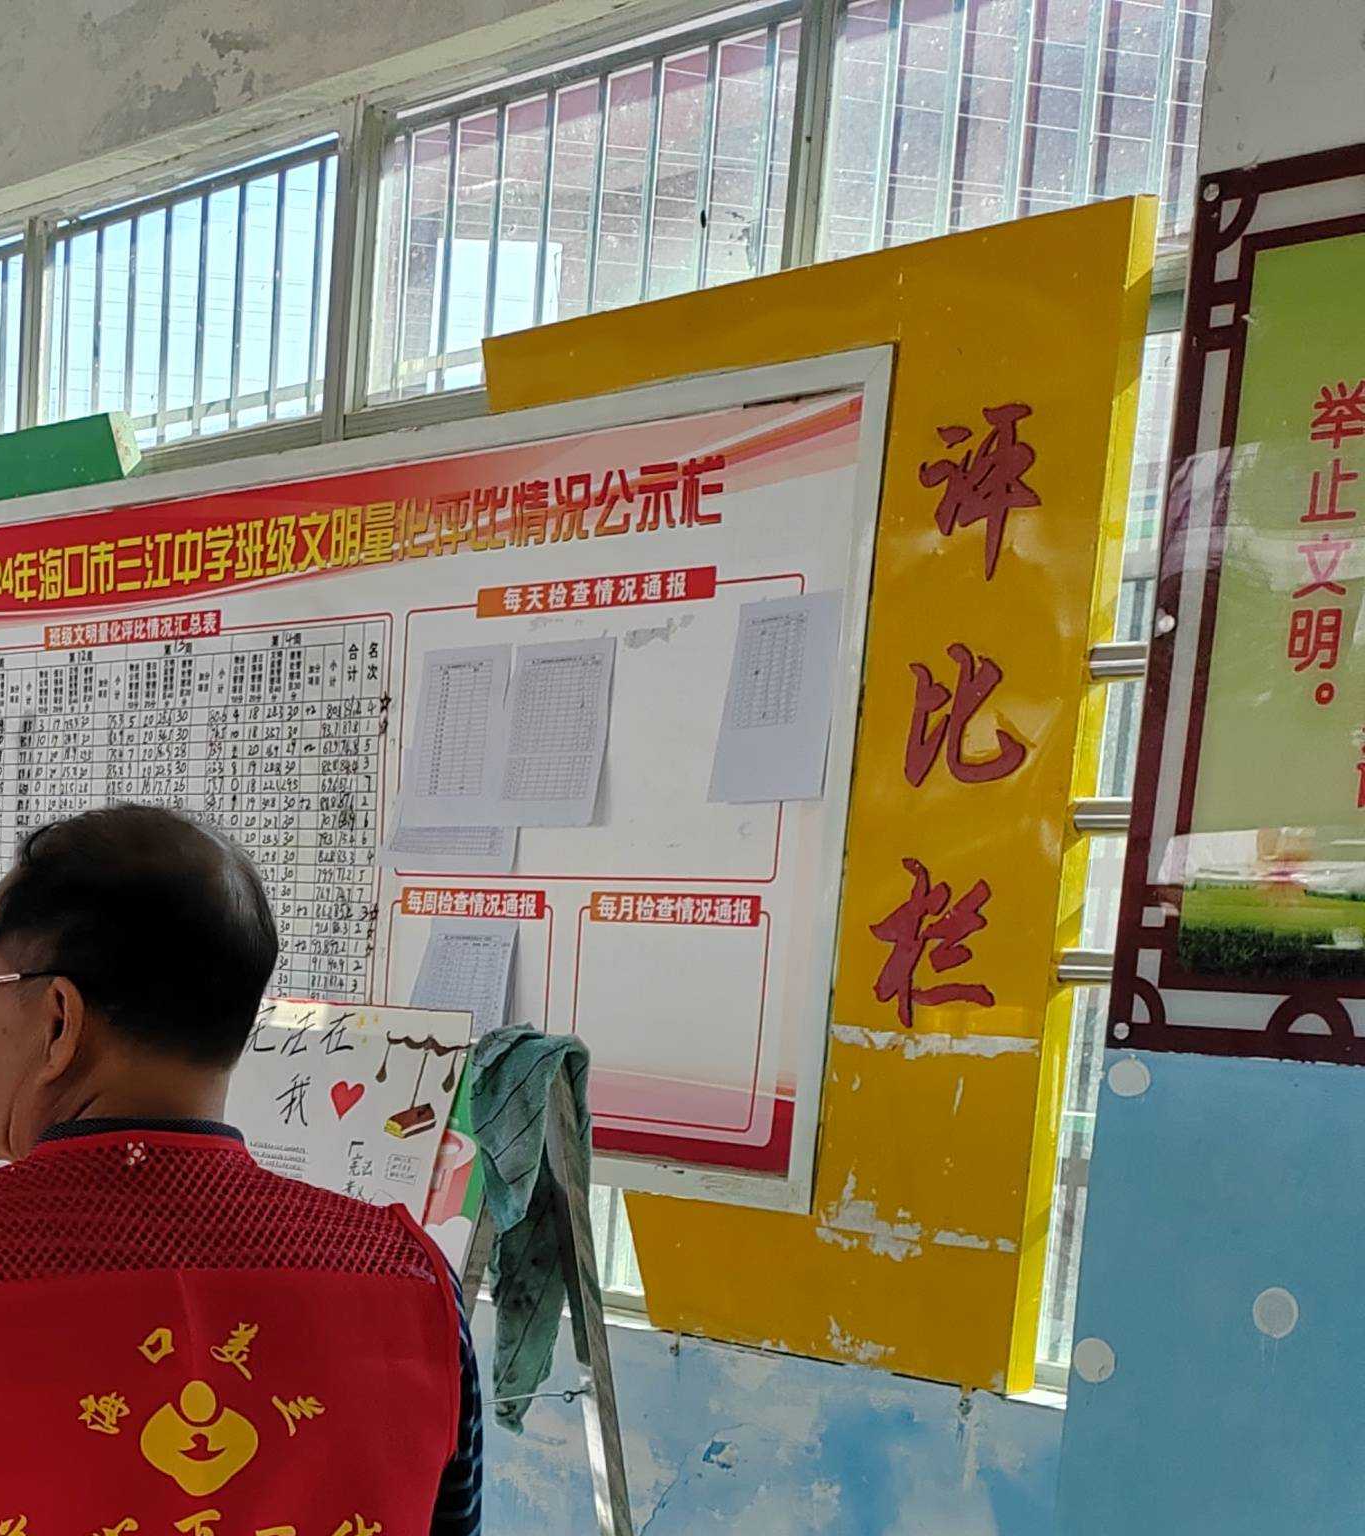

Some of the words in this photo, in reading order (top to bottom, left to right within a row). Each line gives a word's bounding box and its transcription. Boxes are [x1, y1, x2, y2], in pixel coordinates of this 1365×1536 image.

[503, 571, 687, 613] 每天检查情况通报
[48, 612, 218, 646] 班级文明量化评比情况汇总表
[367, 642, 379, 680] 名次
[871, 402, 1042, 1028] 评比栏
[407, 890, 537, 918] 每周检查情况通报
[598, 895, 751, 924] 每月检查情况通报
